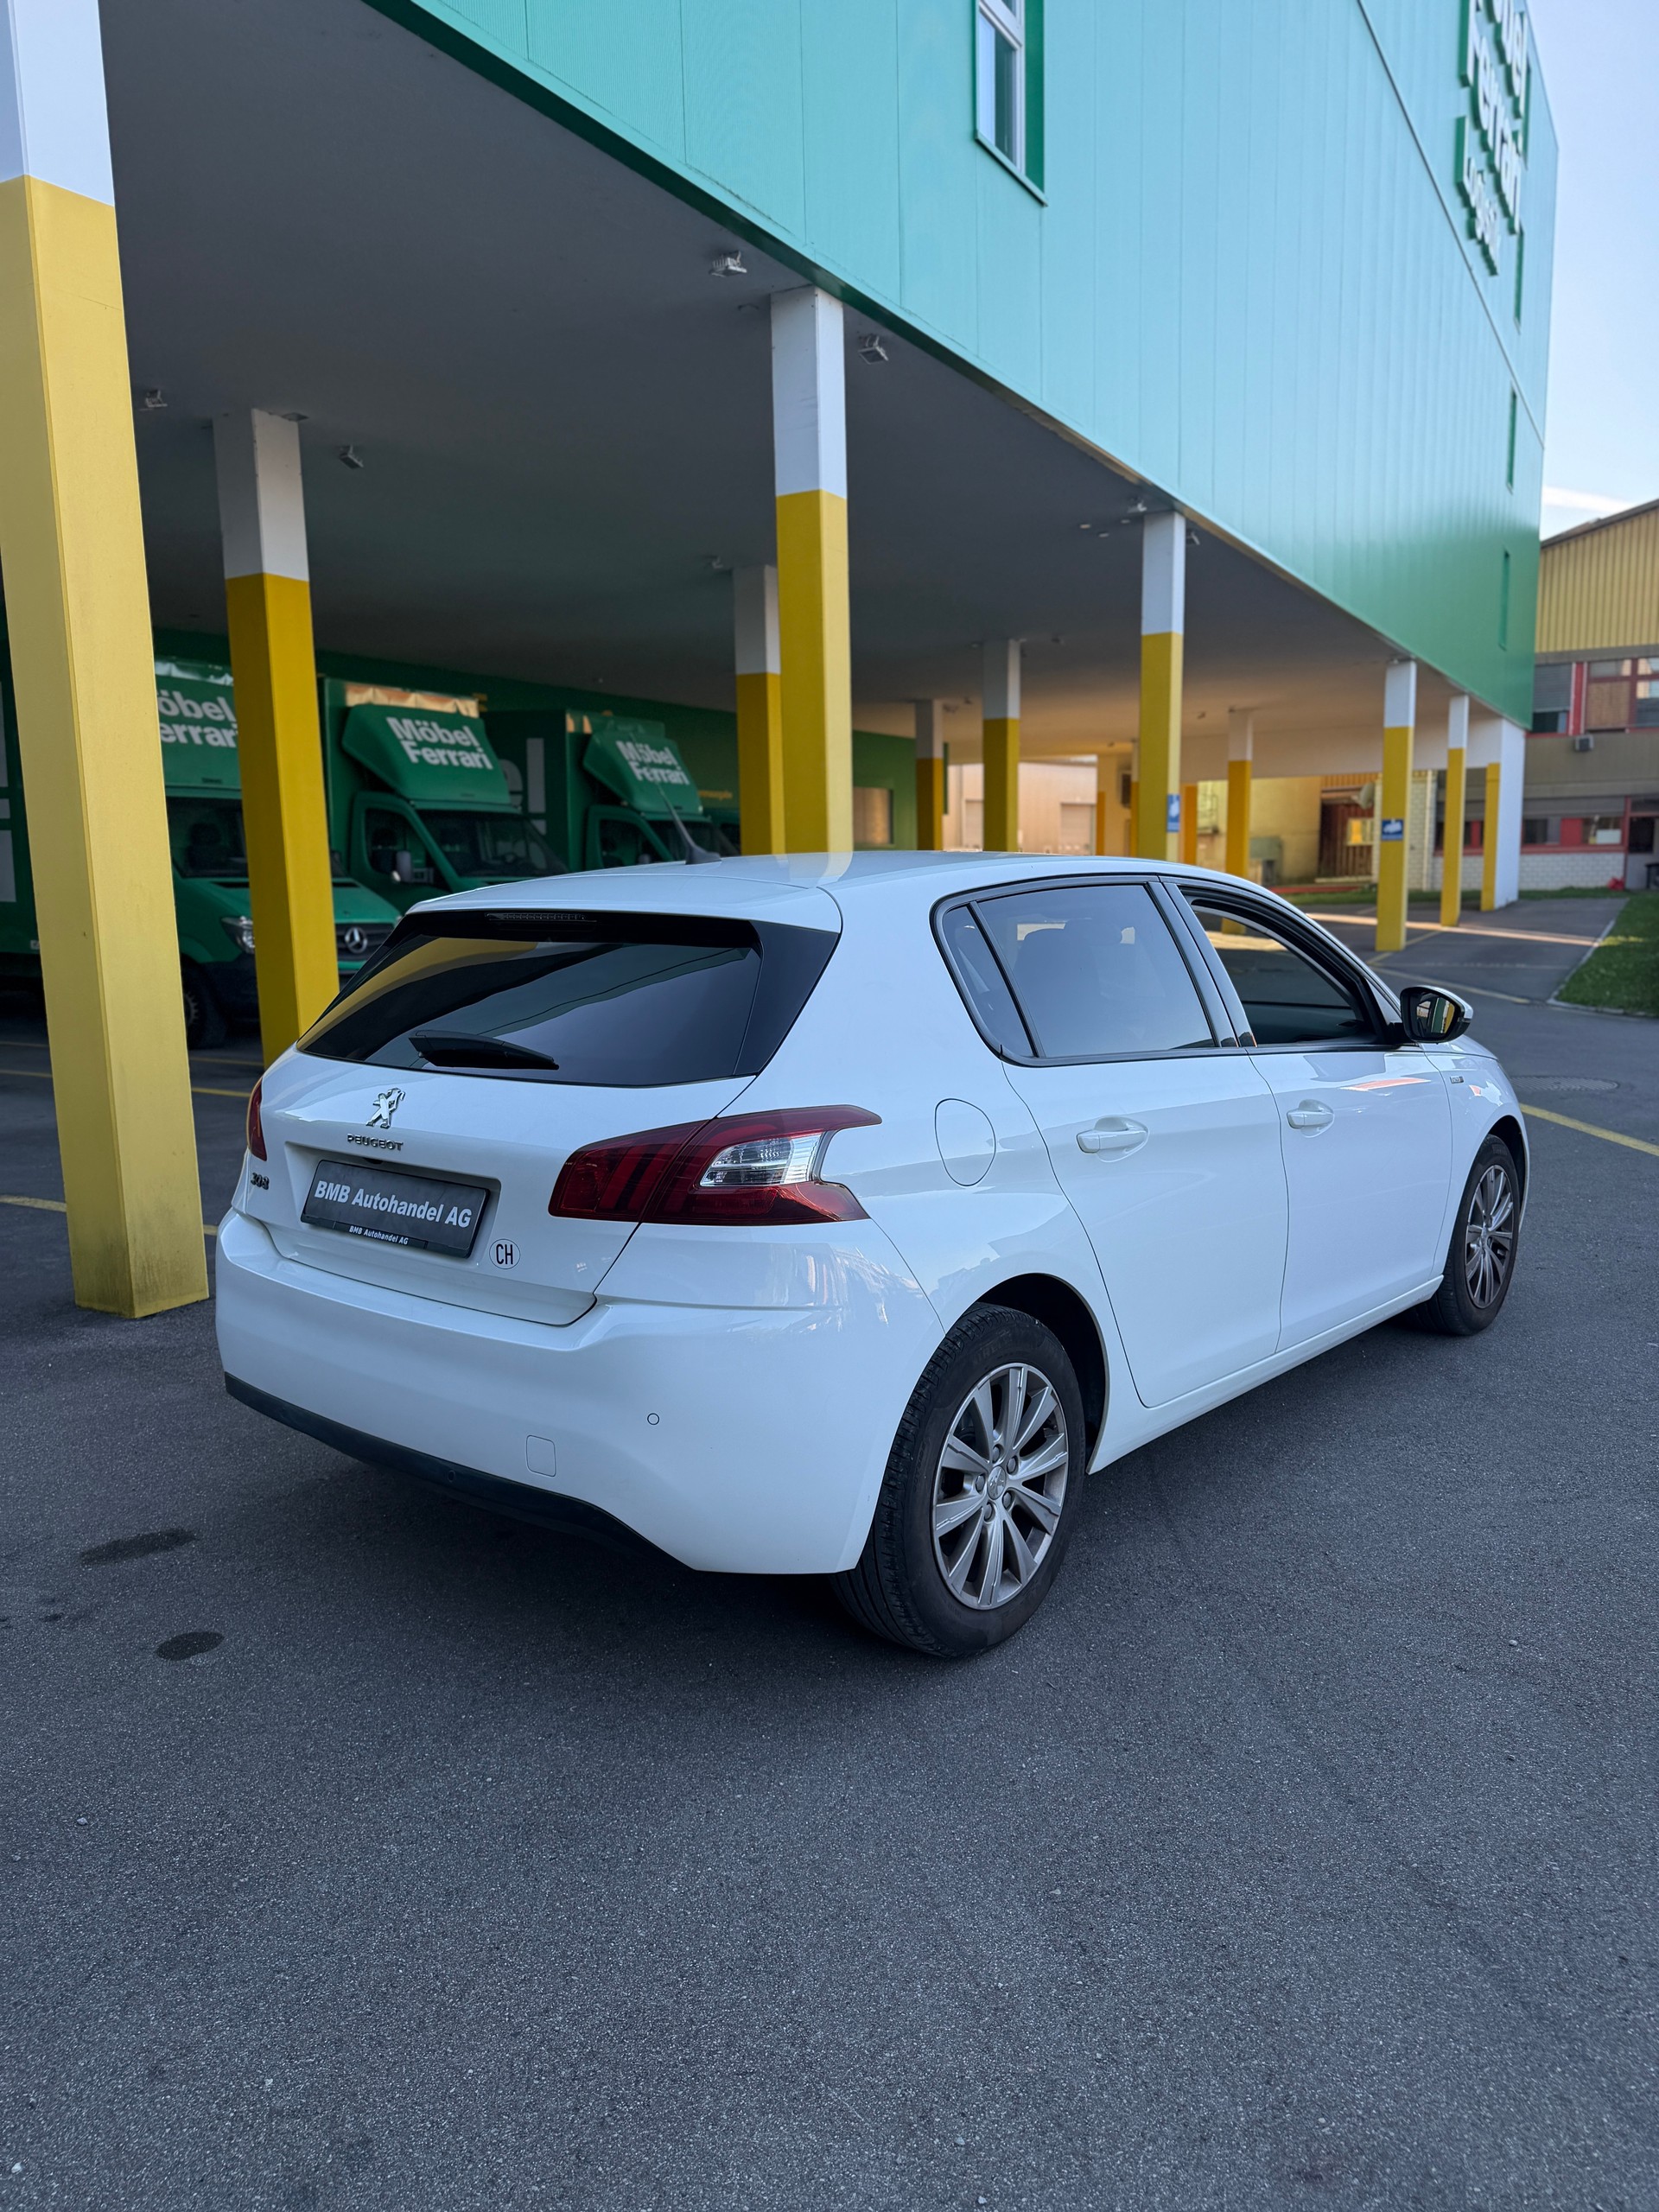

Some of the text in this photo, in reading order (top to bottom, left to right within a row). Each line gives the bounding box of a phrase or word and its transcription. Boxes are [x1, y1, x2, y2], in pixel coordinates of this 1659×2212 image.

[156, 690, 237, 722] öbel
[160, 722, 238, 748] errar
[386, 716, 480, 747] Möbel
[400, 740, 493, 770] Ferrari
[346, 1133, 404, 1151] PEUGEOT
[251, 1172, 270, 1190] 308
[314, 1180, 472, 1228] BMB Autohandel AG
[349, 1225, 409, 1245] BMB Autohandel AG
[495, 1243, 513, 1265] CH
